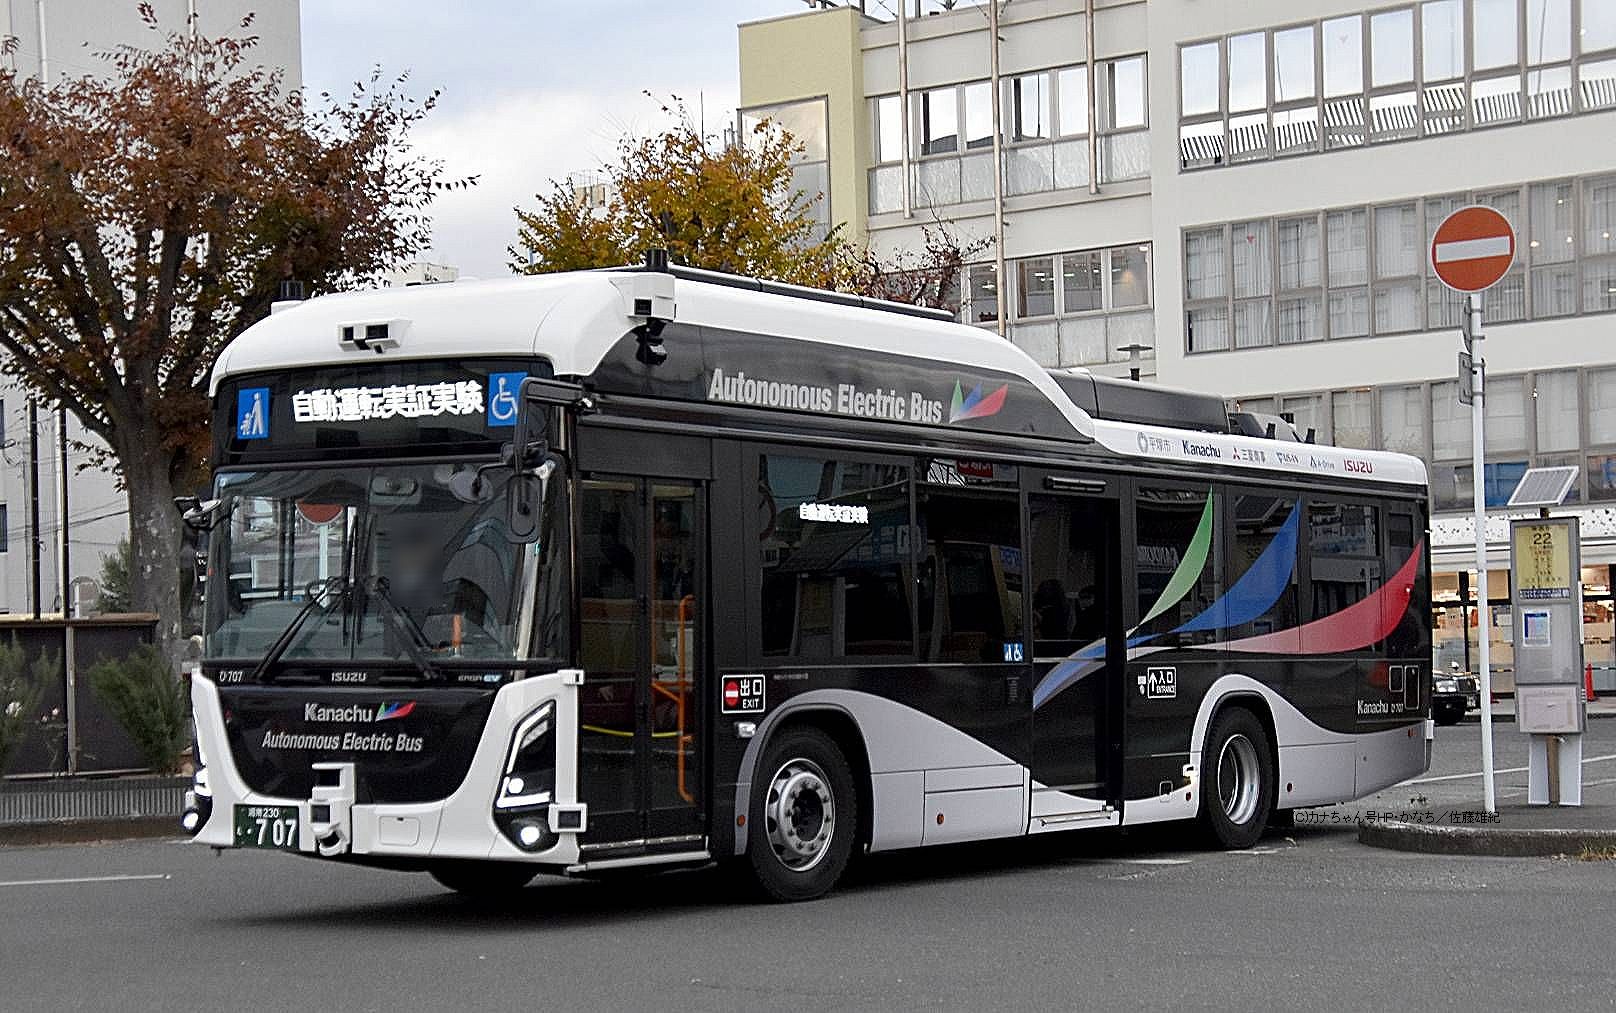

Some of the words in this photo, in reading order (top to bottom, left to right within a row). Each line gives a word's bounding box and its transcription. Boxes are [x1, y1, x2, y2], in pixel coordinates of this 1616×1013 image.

[292, 380, 485, 422] 自動運転実証実験
[709, 367, 832, 412] Autonomous
[837, 384, 905, 420] Electric
[909, 391, 942, 423] Bus
[1182, 439, 1221, 458] Kanachu
[1343, 459, 1373, 474] ISUZU
[1533, 532, 1552, 545] 22
[331, 671, 367, 682] ISUZU
[1159, 670, 1173, 684] 入口
[740, 679, 762, 696] 出口
[742, 699, 760, 708] EXIT
[1357, 699, 1388, 715] Kanachu
[304, 702, 373, 723] Kanachu
[262, 730, 340, 750] Autonomous
[342, 732, 393, 751] Electric
[395, 733, 424, 752] Bus
